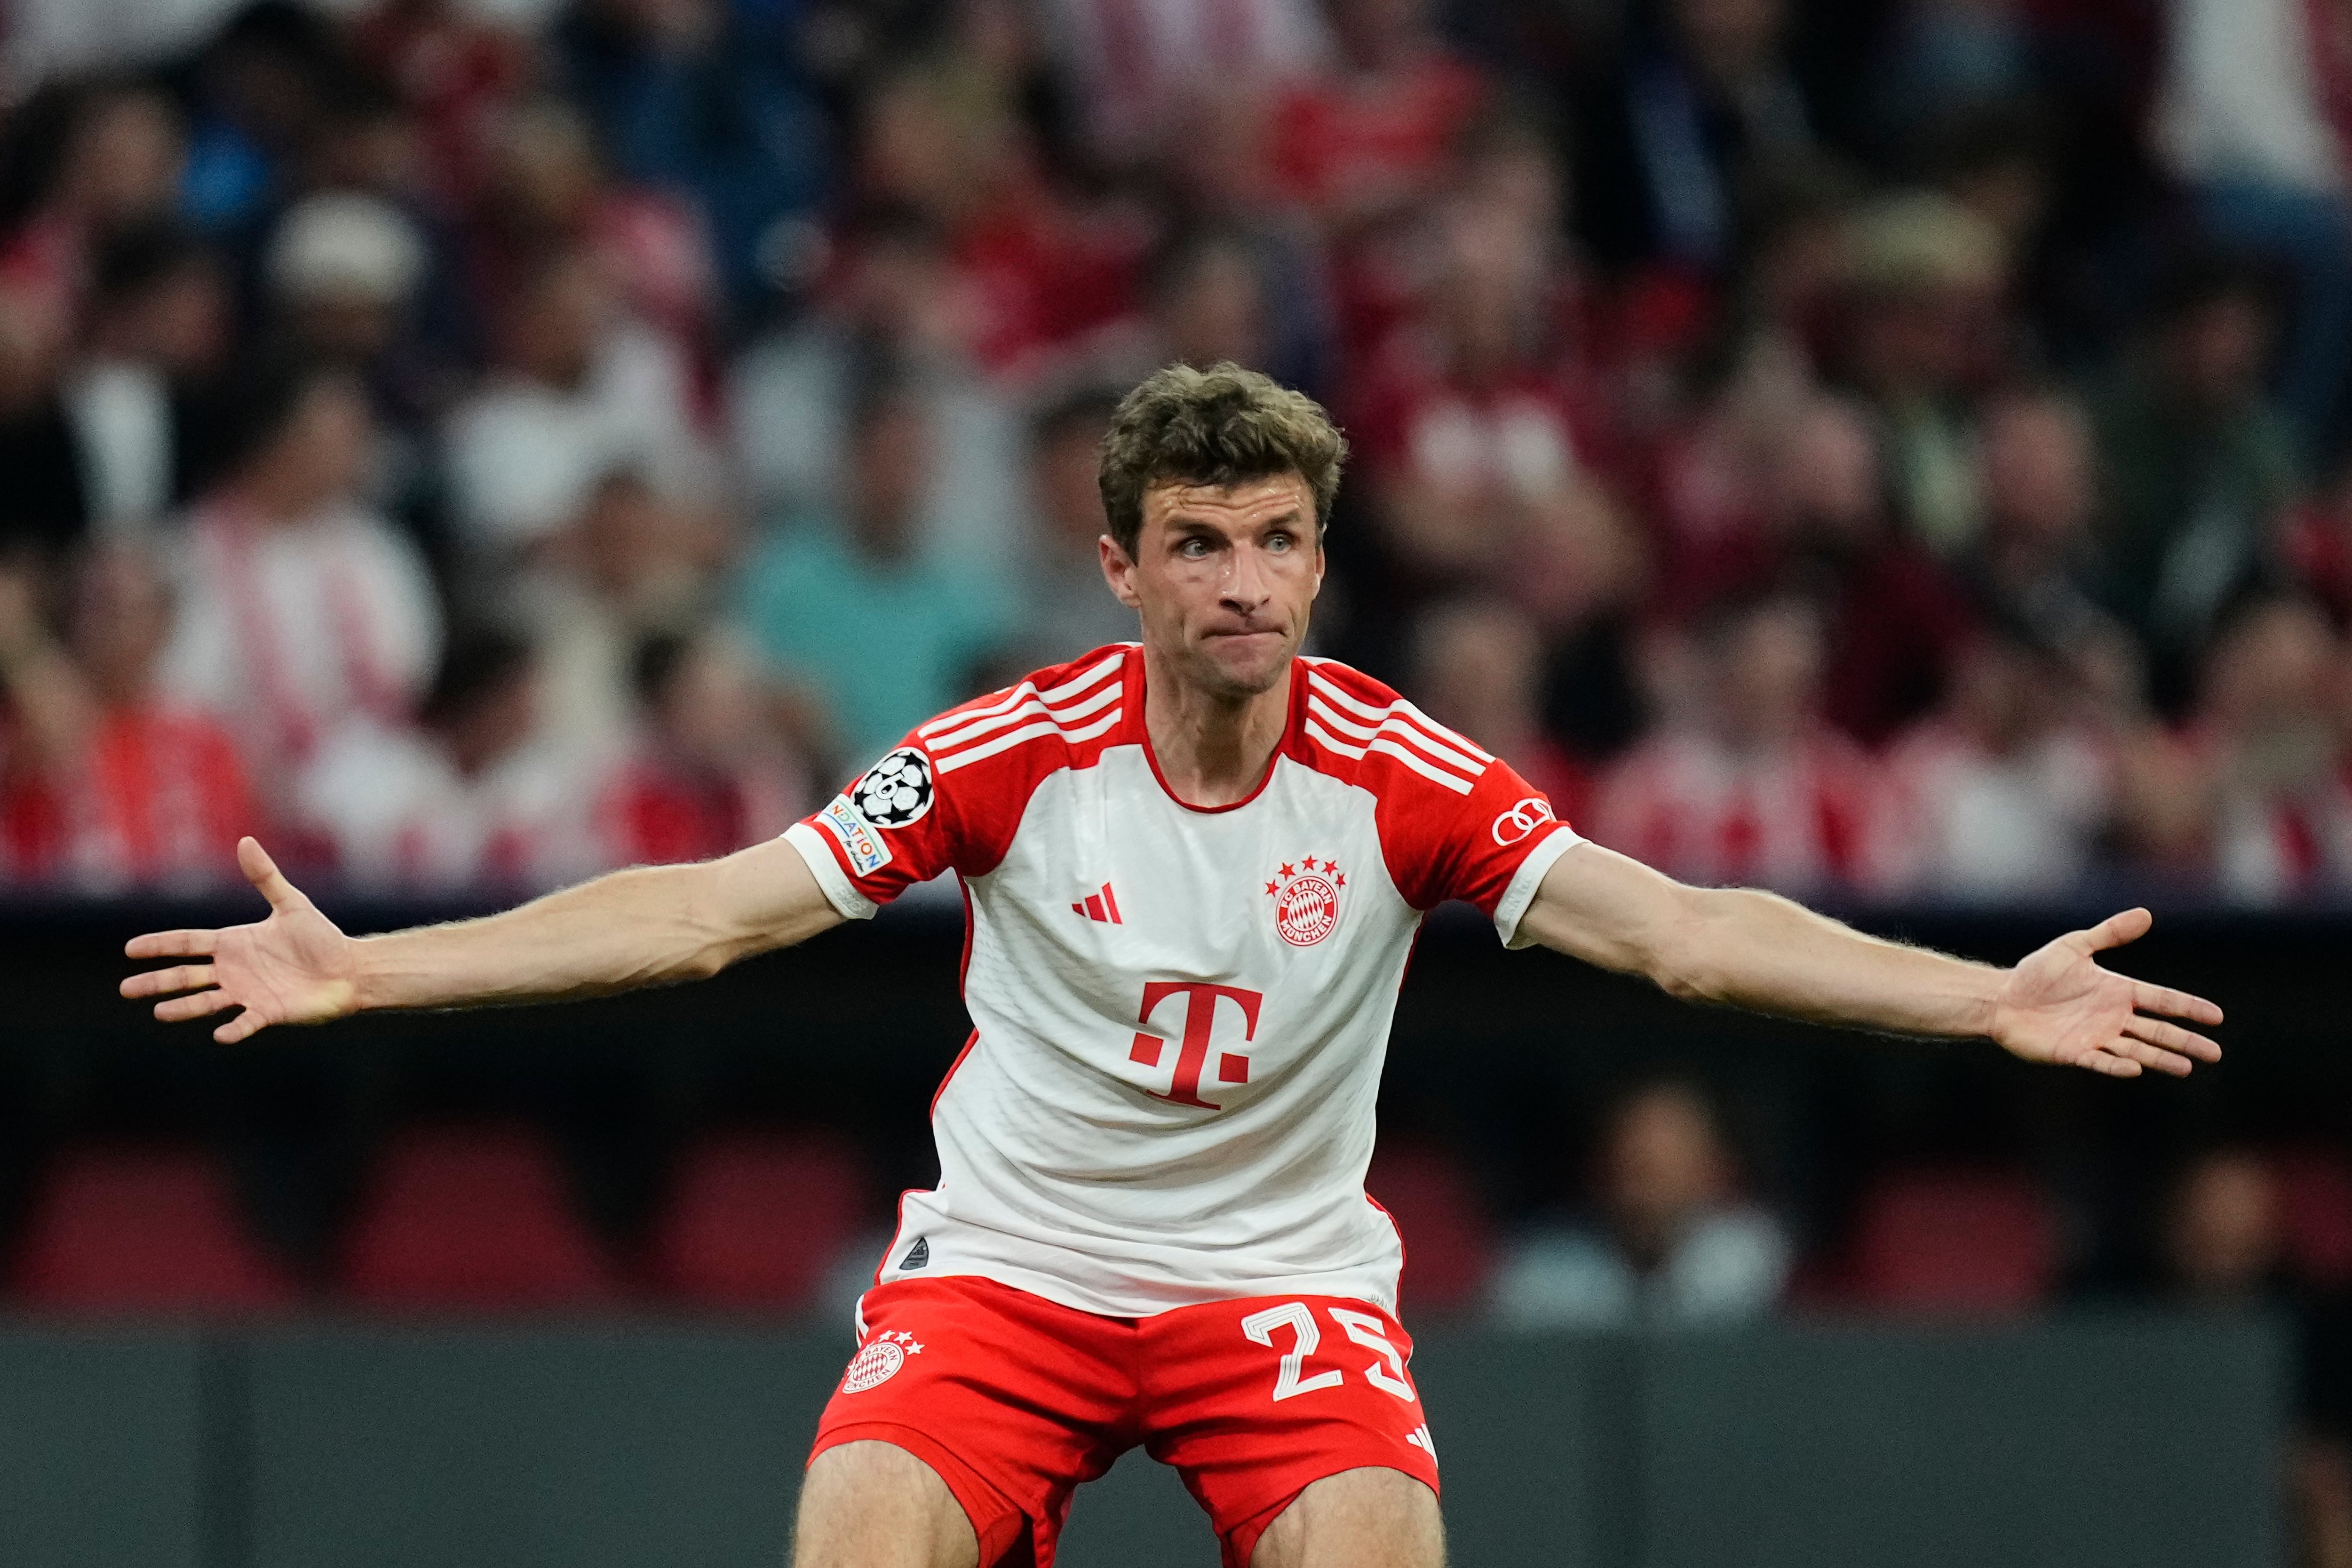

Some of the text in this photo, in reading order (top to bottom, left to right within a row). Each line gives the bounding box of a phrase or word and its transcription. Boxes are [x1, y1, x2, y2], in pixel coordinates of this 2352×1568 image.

[1293, 880, 1333, 905] BAYERN
[1129, 982, 1263, 1110] T
[1240, 1301, 1415, 1403] 25
